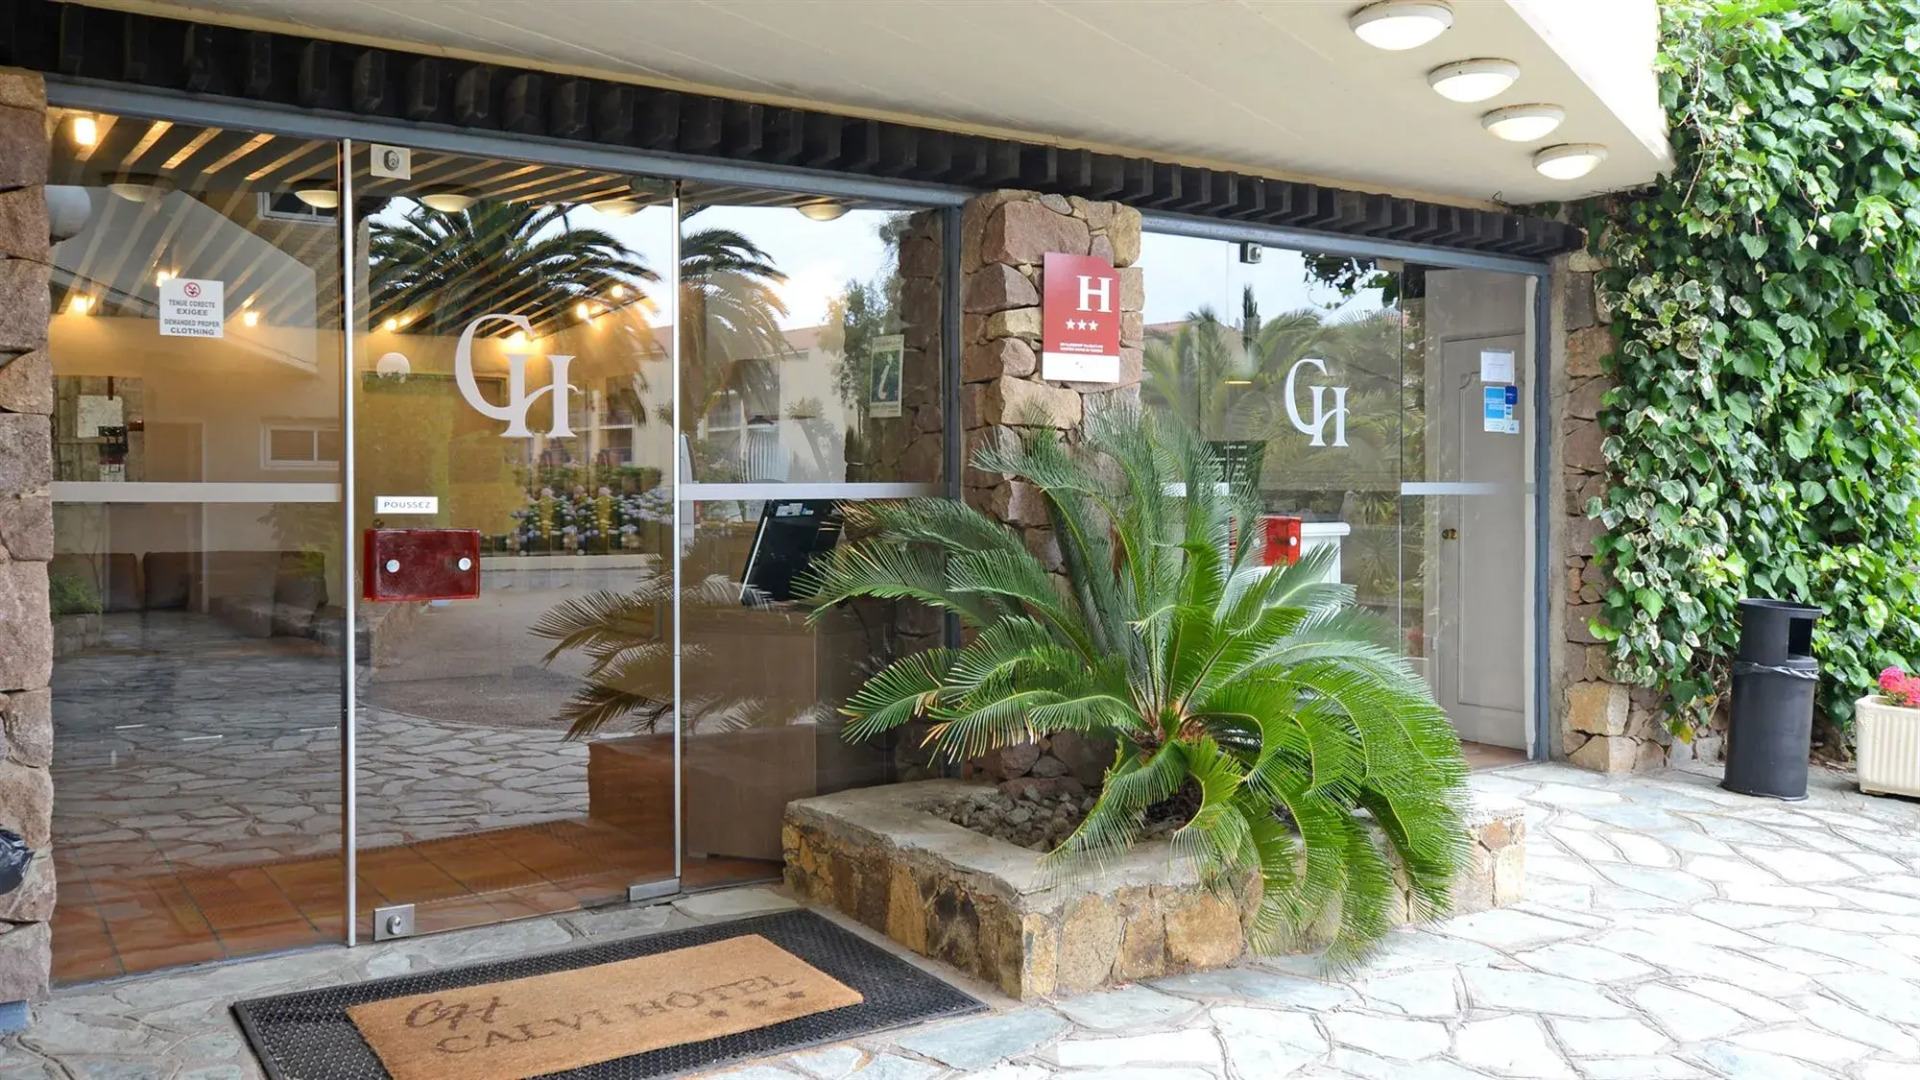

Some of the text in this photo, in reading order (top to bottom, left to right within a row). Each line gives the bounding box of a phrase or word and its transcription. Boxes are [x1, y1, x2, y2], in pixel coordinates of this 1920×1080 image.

[1076, 274, 1113, 313] H
[168, 299, 188, 307] TENUE
[176, 308, 208, 316] EXIGEE
[164, 318, 220, 328] DEMANDED PROPER
[170, 326, 215, 335] CLOTHING
[383, 501, 431, 509] POUSSEZ
[436, 1009, 613, 1054] CALVI
